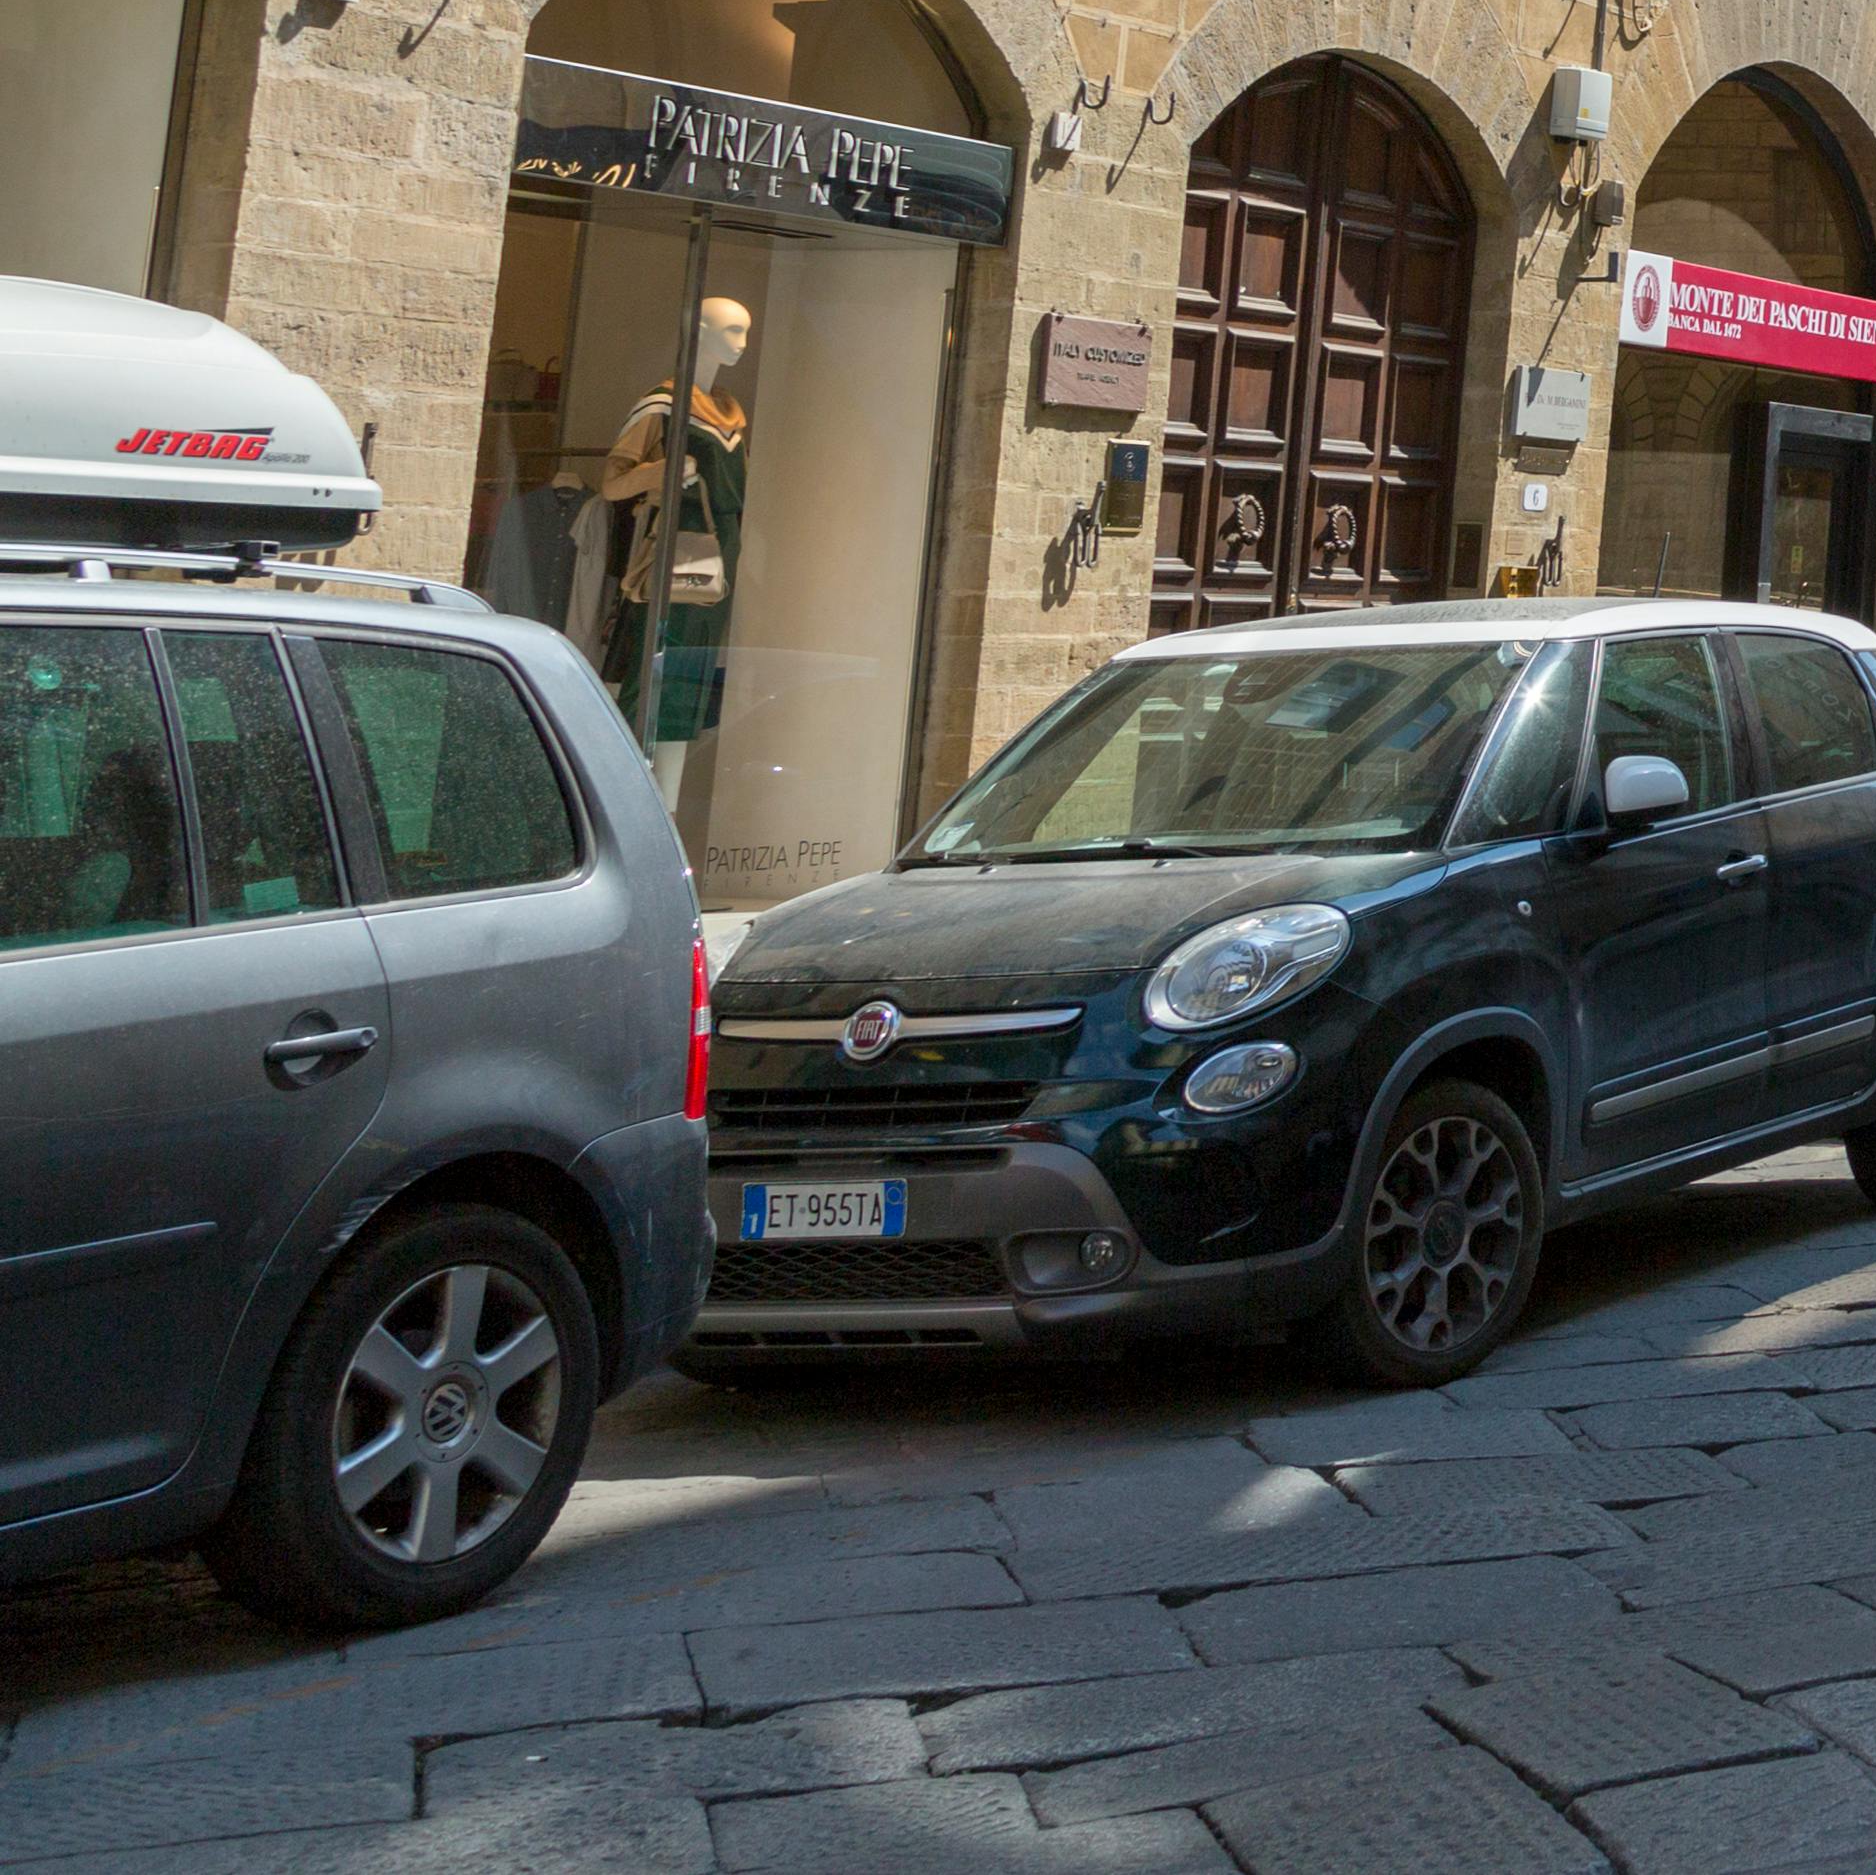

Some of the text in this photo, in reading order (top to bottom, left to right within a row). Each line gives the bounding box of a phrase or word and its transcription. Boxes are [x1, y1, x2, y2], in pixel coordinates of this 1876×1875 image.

[649, 95, 915, 191] PATRIZIA PEPE
[643, 152, 911, 218] FIRENZE
[1669, 283, 1733, 318] MONTE
[1737, 295, 1766, 324] DEI
[1769, 300, 1827, 336] PASCHI
[1828, 311, 1848, 339] DI
[1702, 320, 1722, 337] DAL
[1723, 322, 1742, 339] 1472
[115, 427, 271, 461] JETBAG
[705, 840, 842, 875] PATRIZIA PEPE
[703, 869, 840, 889] FIRENZE
[856, 1019, 882, 1041] FIAT
[768, 1194, 799, 1228] ET
[807, 1192, 882, 1227] 955TA
